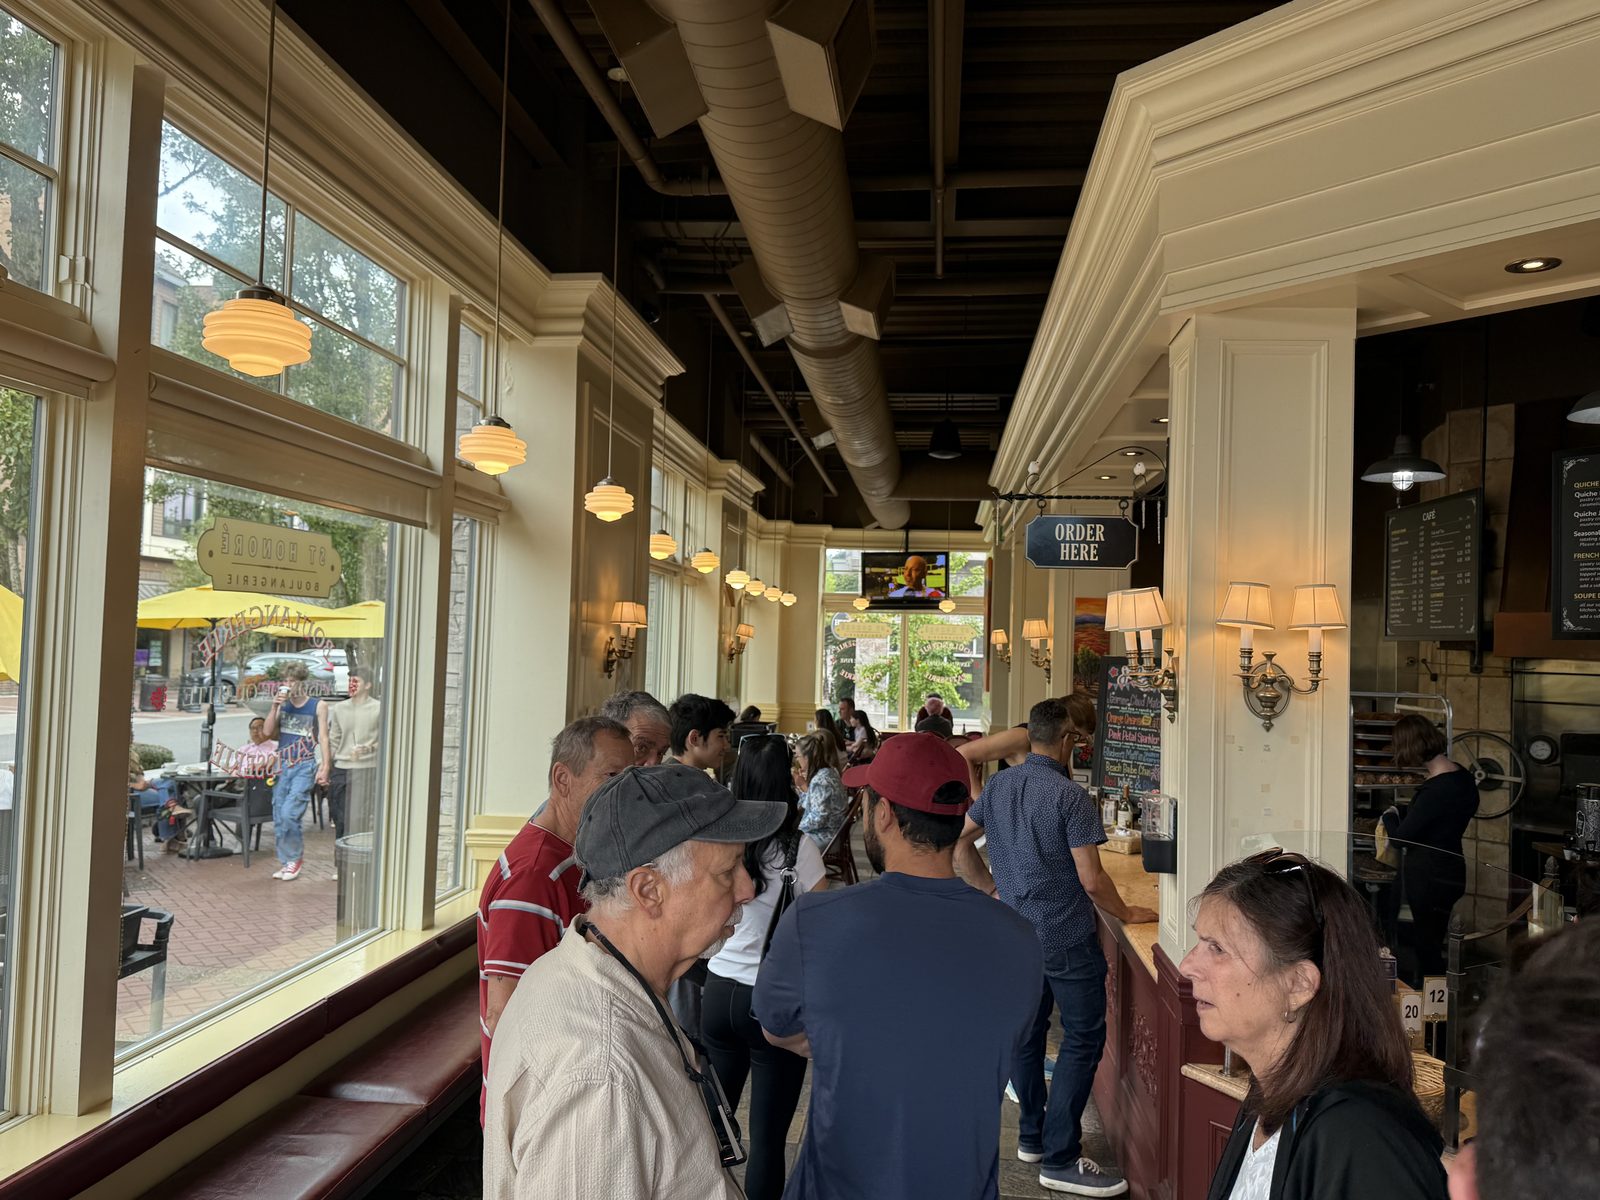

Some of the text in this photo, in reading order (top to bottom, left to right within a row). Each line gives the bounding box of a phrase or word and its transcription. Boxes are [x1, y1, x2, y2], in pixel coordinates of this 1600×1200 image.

[1573, 480, 1600, 488] QUICHE
[1574, 491, 1598, 499] Quiche
[1055, 523, 1105, 541] ORDER
[1060, 543, 1099, 561] HERE
[1573, 592, 1597, 600] SOUPE
[1429, 989, 1445, 1003] 12
[1404, 1004, 1419, 1019] 20
